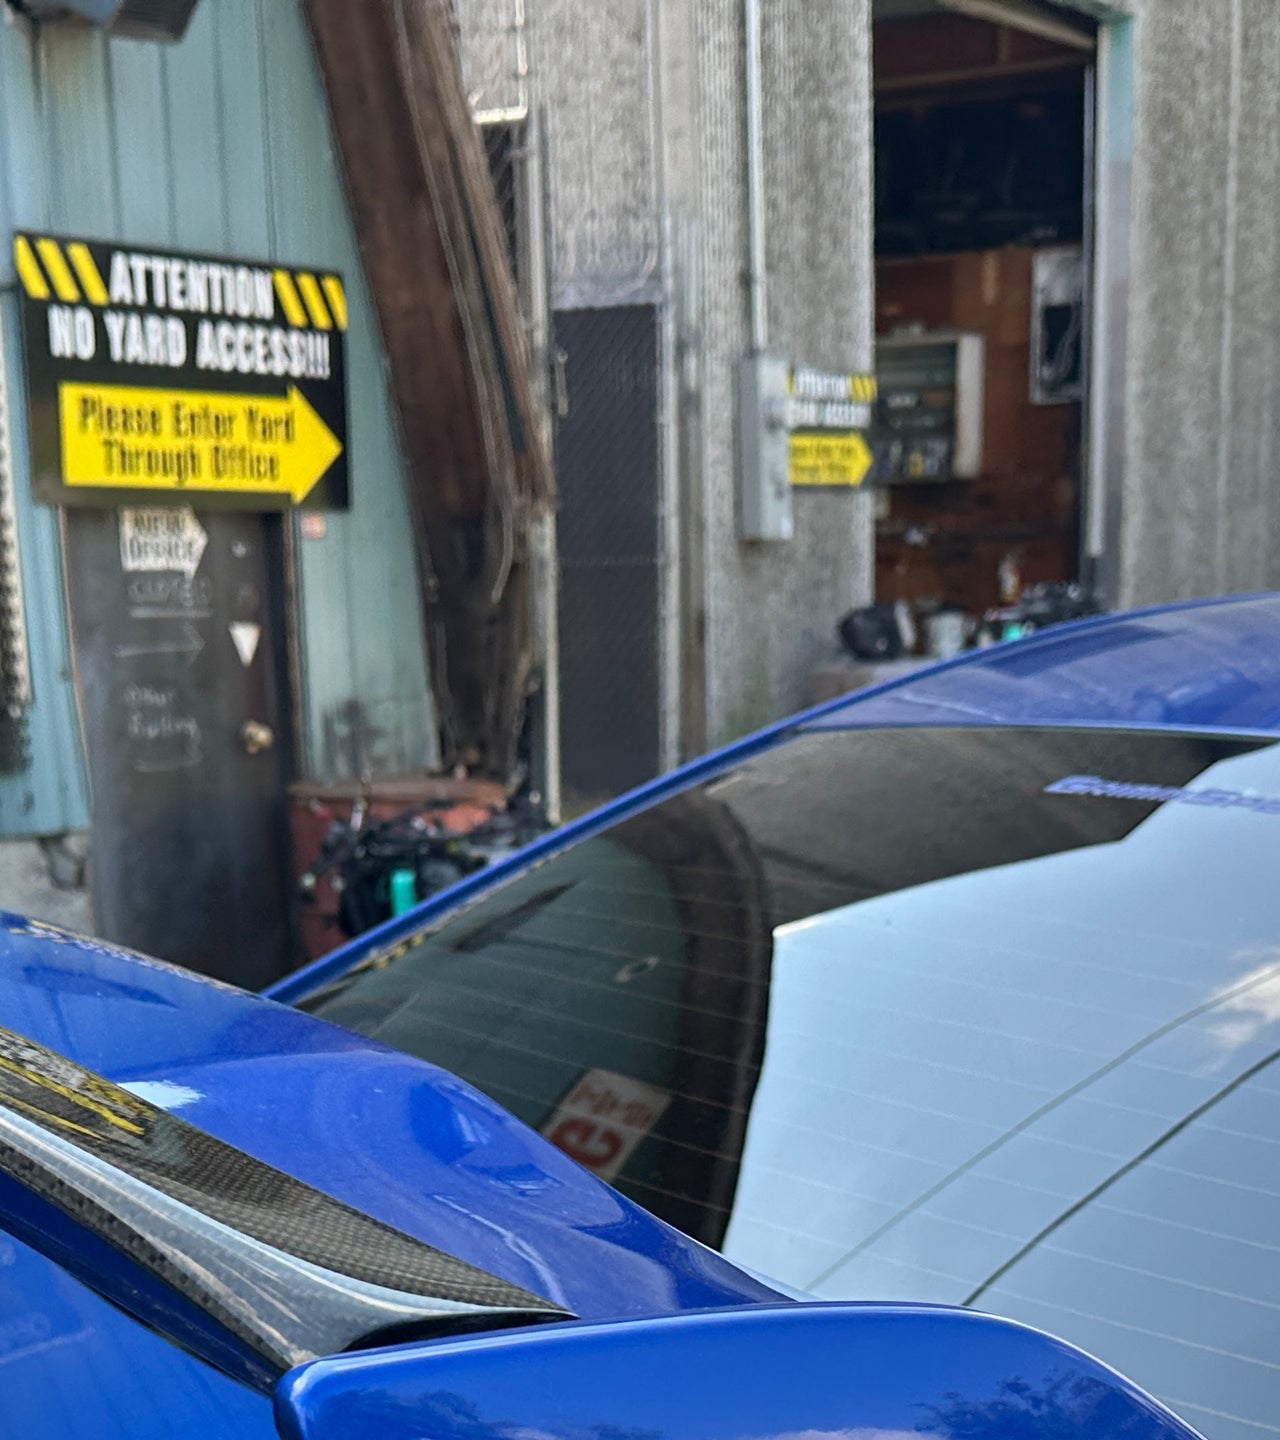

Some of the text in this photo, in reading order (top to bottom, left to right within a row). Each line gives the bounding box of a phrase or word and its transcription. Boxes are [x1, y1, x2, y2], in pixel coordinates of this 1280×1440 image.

[108, 250, 274, 320] ATTENTION
[47, 304, 97, 361] NO
[103, 310, 187, 368] YARD
[78, 394, 294, 443] Please Enter Yard
[102, 437, 280, 487] Through Office
